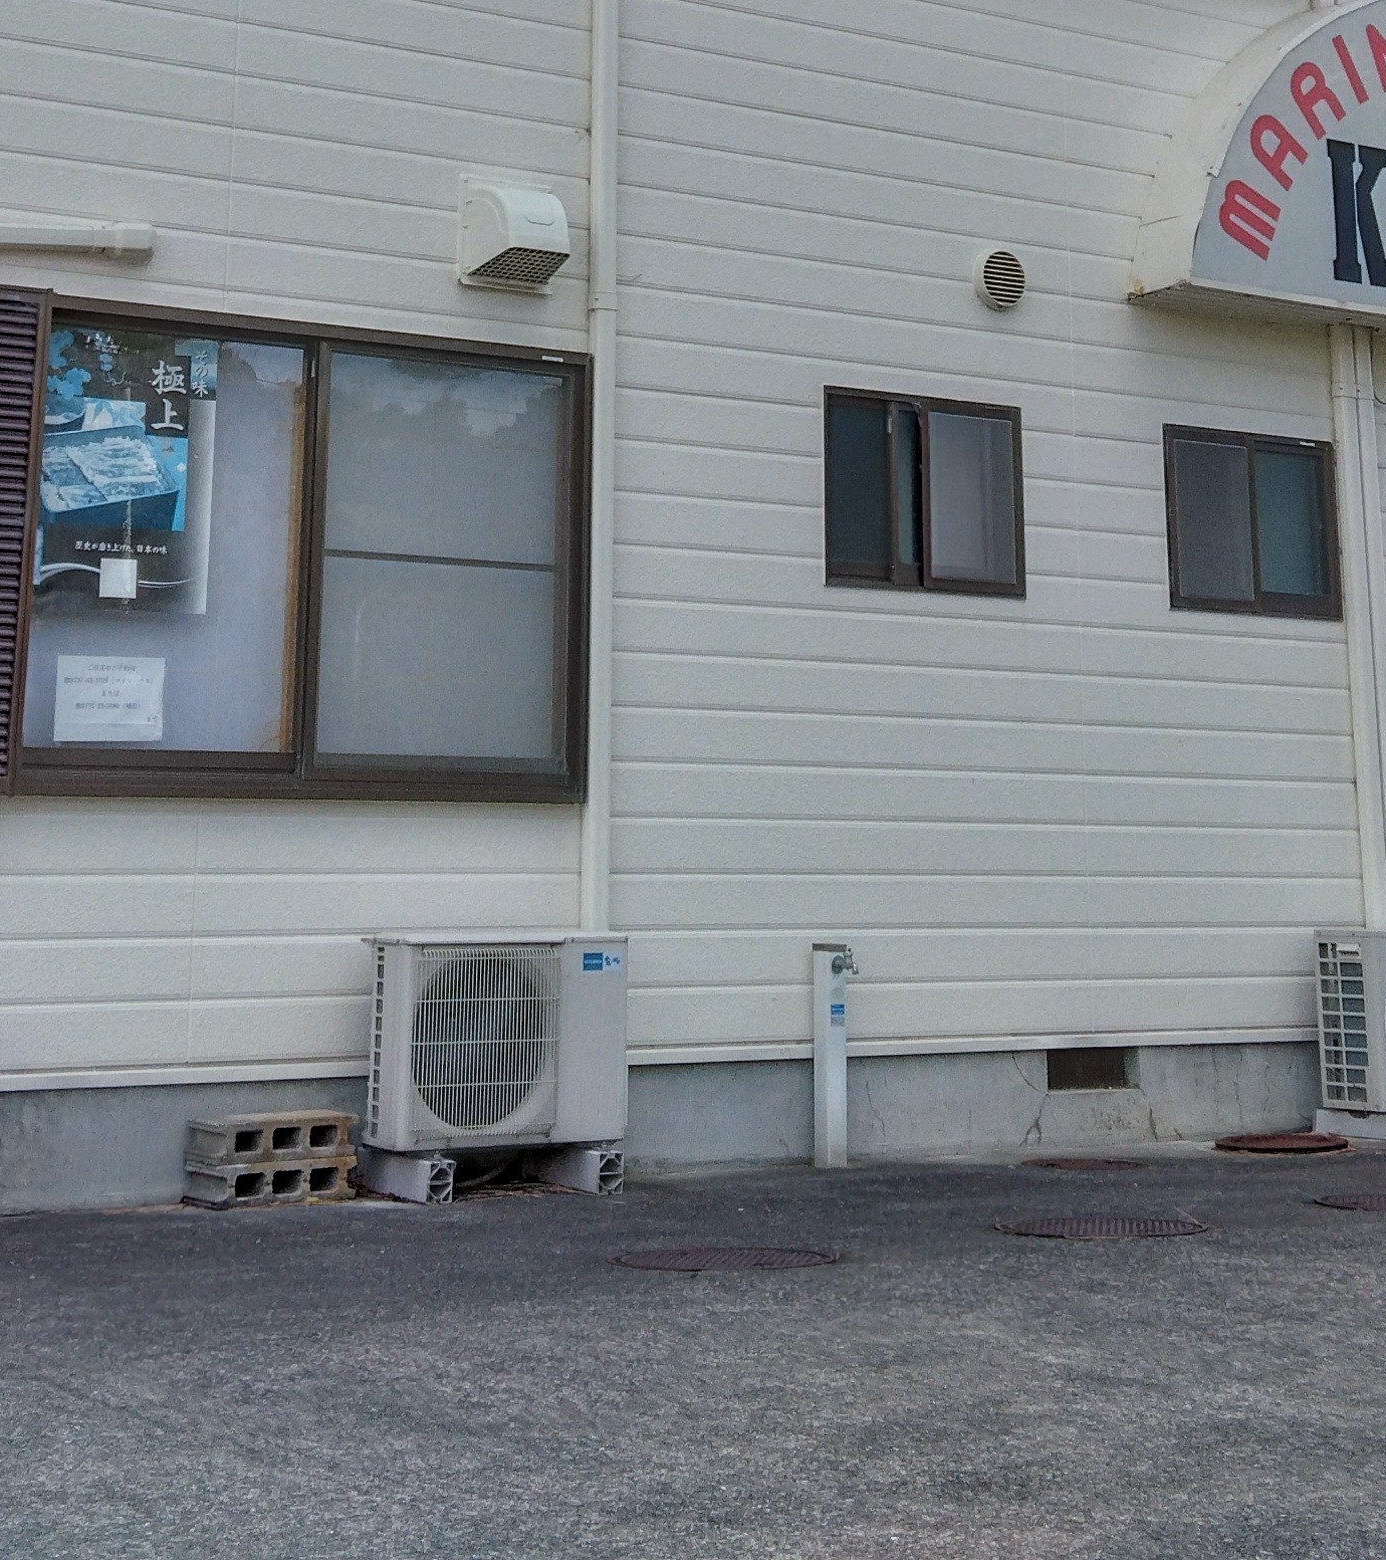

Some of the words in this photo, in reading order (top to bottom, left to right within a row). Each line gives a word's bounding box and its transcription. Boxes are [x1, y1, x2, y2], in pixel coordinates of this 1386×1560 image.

[150, 359, 187, 431] 極上
[192, 350, 209, 398] その味
